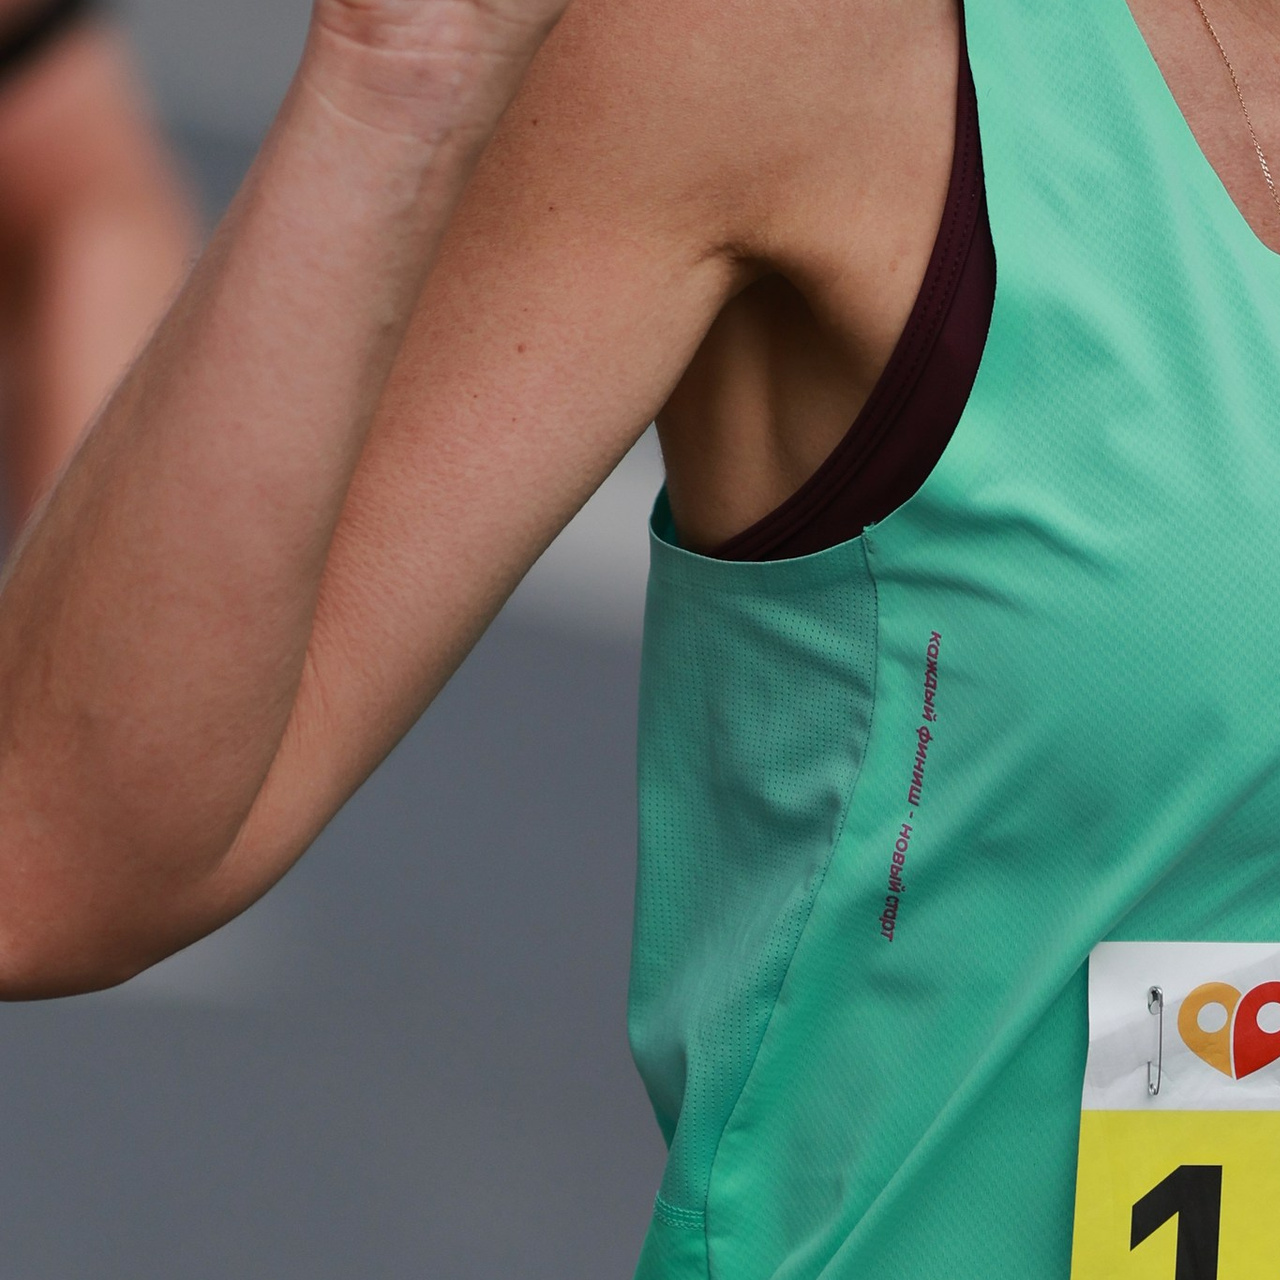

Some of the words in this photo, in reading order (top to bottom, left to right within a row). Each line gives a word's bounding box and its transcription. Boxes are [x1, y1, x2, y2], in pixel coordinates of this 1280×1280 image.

[923, 630, 941, 722] каждый
[908, 726, 933, 807] финиш
[888, 823, 913, 892] новый
[879, 895, 899, 942] старт
